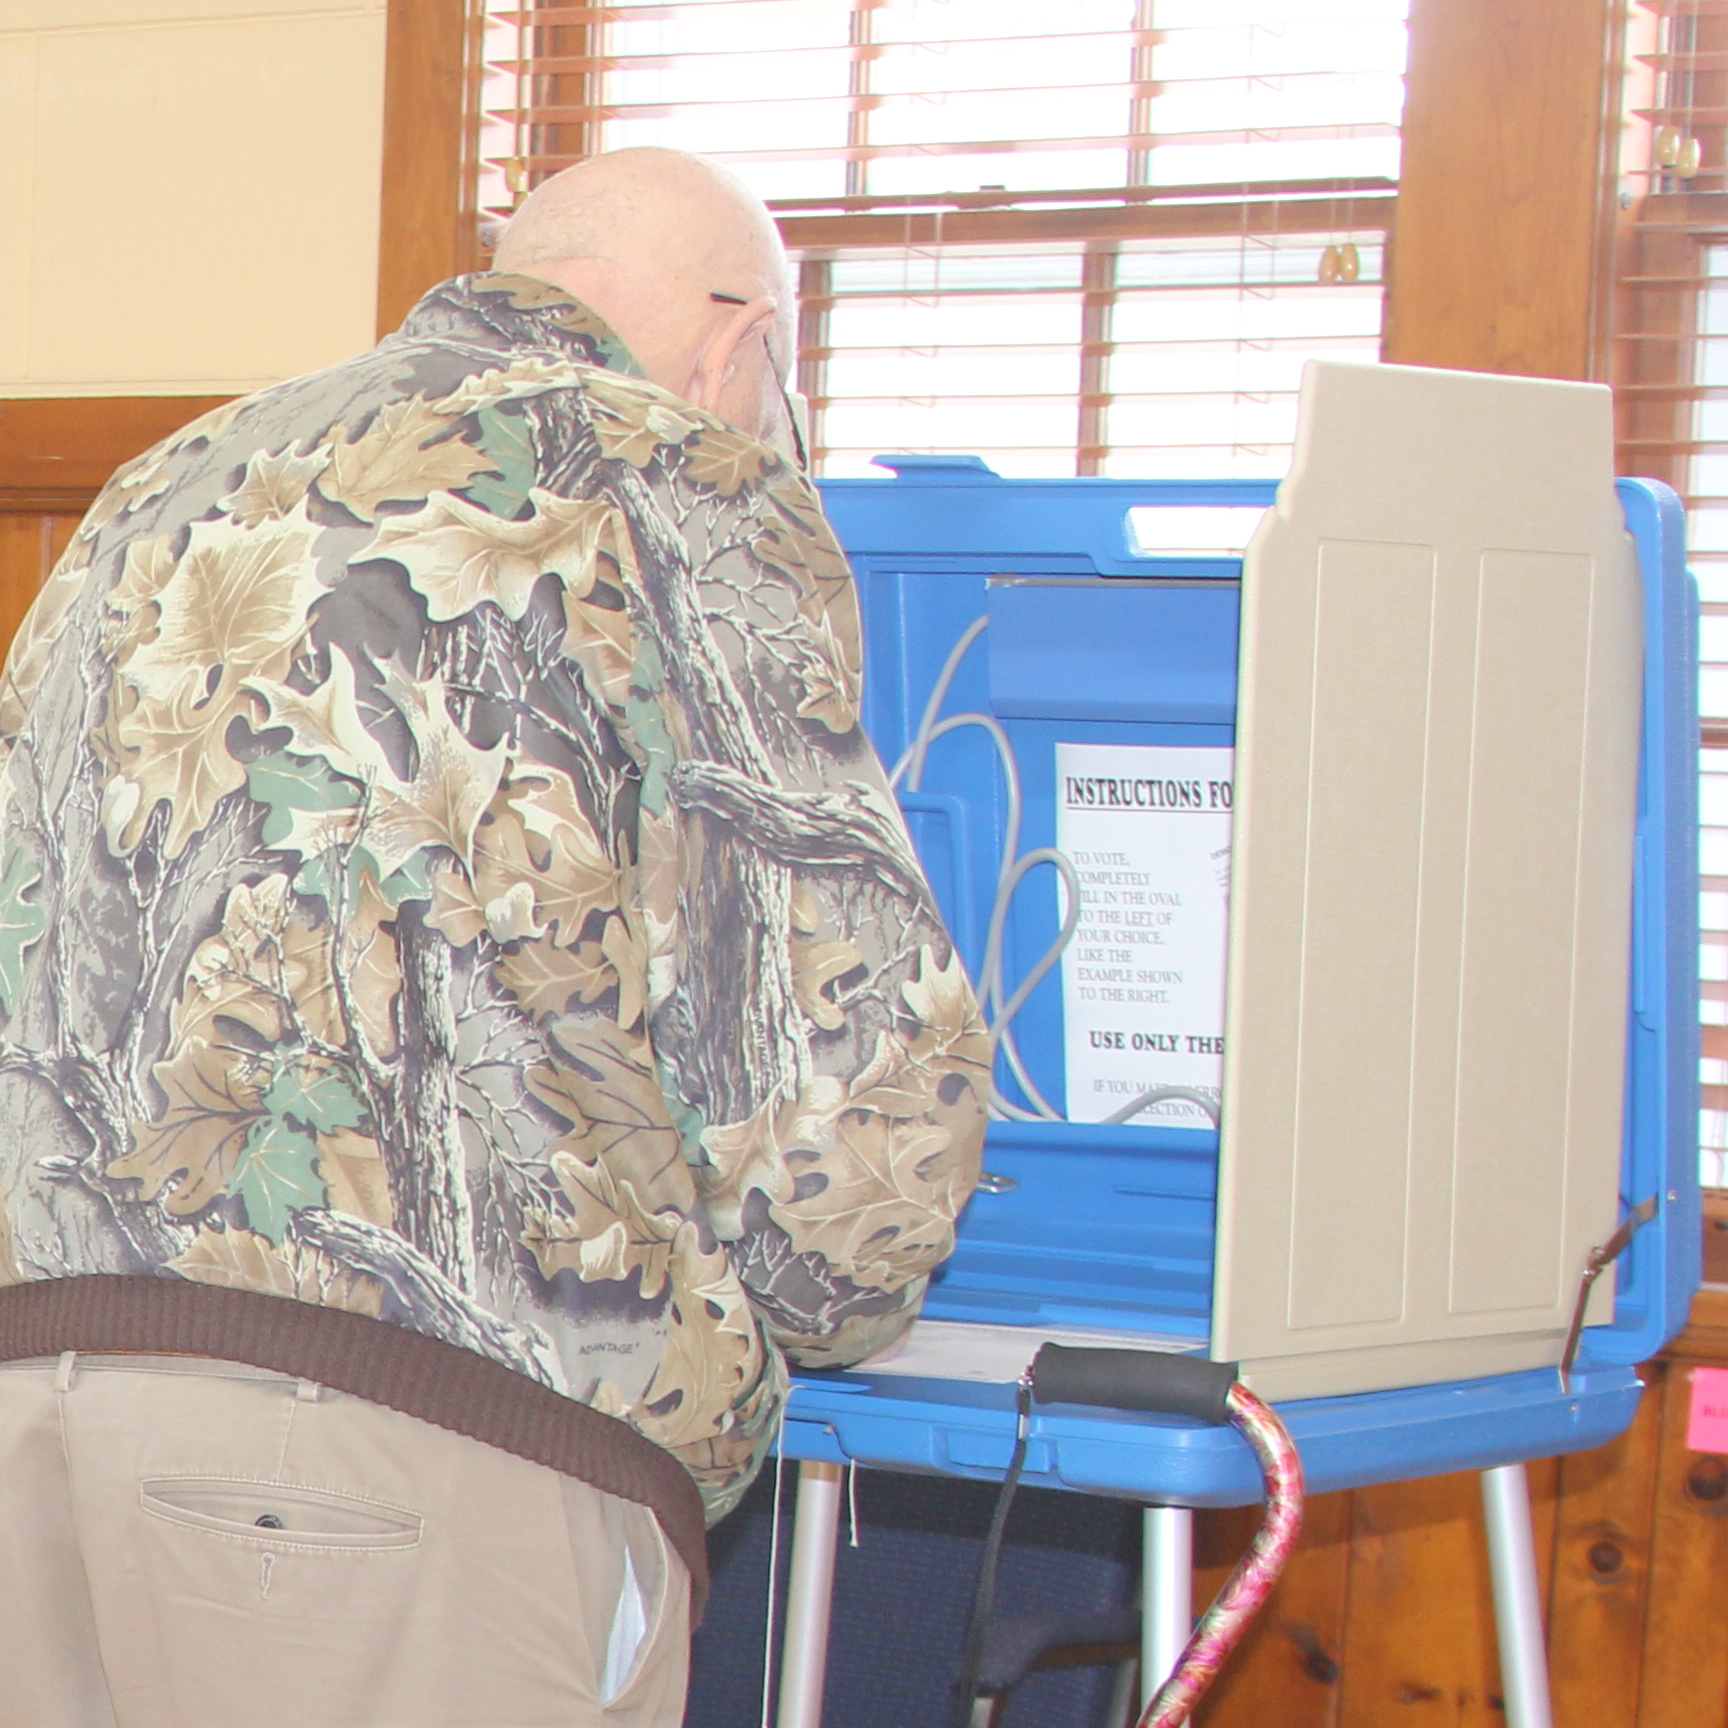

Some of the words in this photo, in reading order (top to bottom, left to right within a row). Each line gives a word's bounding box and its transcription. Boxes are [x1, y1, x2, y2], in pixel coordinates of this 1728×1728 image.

[1066, 777, 1202, 807] INSTRUCTIONS
[1072, 851, 1090, 865] TO
[1080, 890, 1100, 904] ILL
[1103, 891, 1118, 904] IN
[1120, 892, 1146, 905] THE
[1148, 892, 1182, 907] OVAL
[1096, 910, 1121, 924] THE
[1124, 911, 1153, 926] LEFT
[1156, 911, 1173, 926] OF
[1076, 929, 1112, 943] YOUR
[1077, 948, 1104, 962] LIKE
[1107, 949, 1132, 963] THE
[1077, 968, 1133, 982] EXAMPLE
[1136, 970, 1183, 985] SHOWN
[1079, 987, 1096, 1001] TO
[1099, 987, 1124, 1002] THE
[1089, 1031, 1126, 1050] USE
[1131, 1032, 1180, 1052] ONLY
[1185, 1035, 1224, 1054] THE
[1094, 1079, 1104, 1093] IF
[1106, 1080, 1132, 1094] YOU
